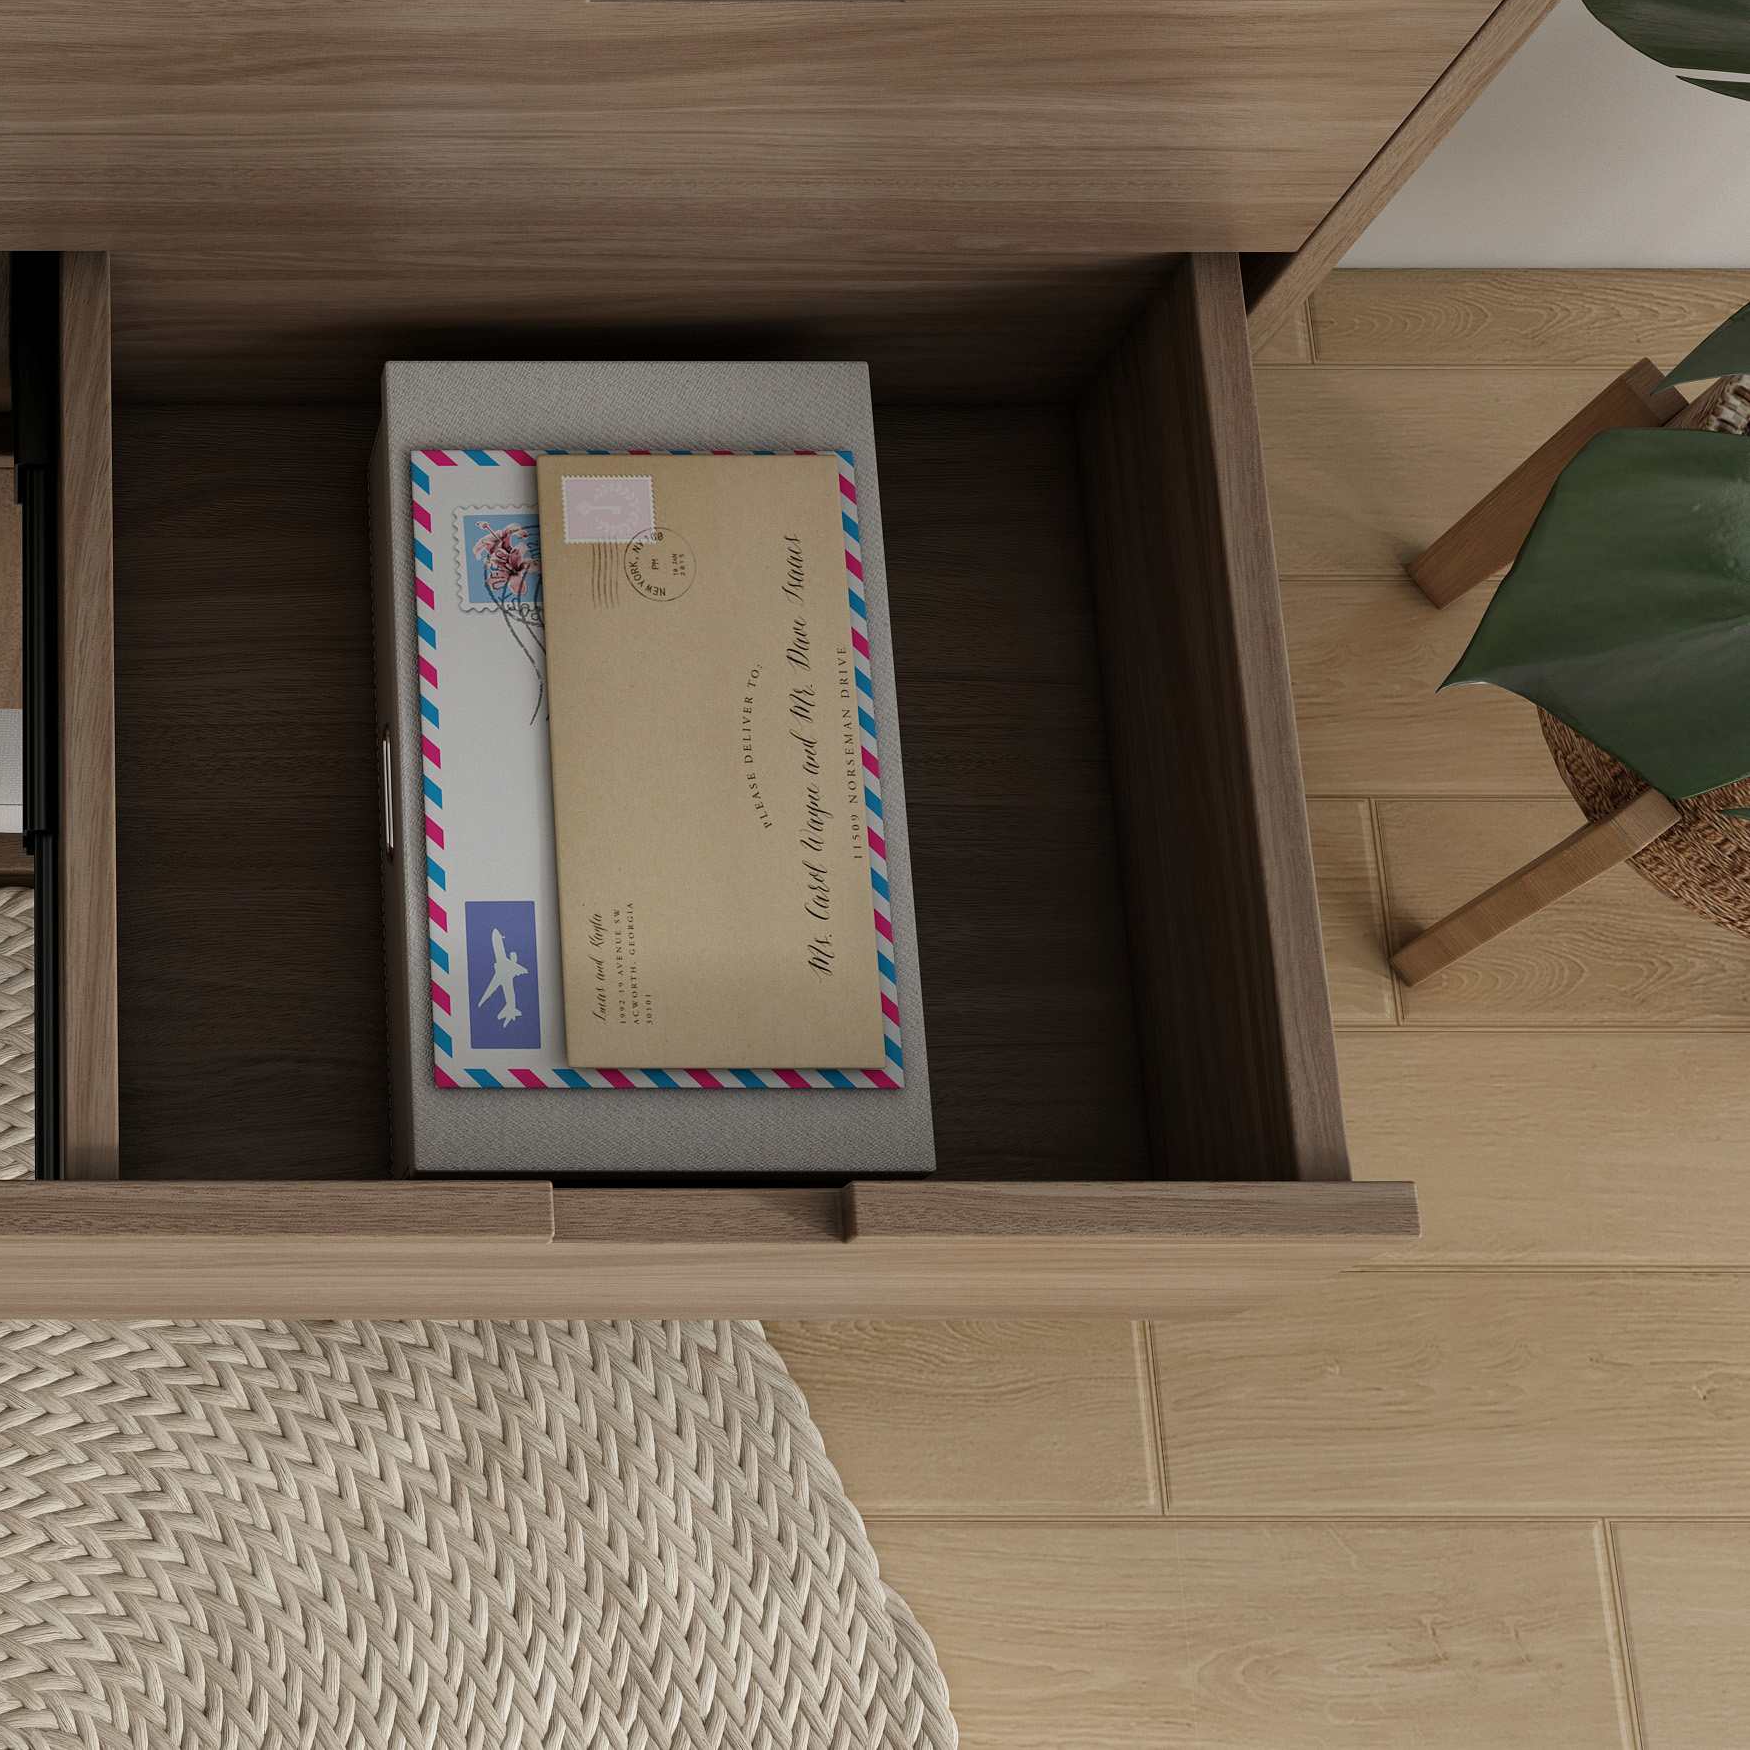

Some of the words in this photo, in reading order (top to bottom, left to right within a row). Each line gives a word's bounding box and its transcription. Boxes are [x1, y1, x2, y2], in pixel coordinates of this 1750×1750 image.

[651, 558, 659, 570] PM
[781, 534, 804, 602] Isaacs
[786, 616, 810, 673] Dave
[836, 647, 850, 698] DRIVE
[789, 684, 816, 724] Mr.
[742, 696, 754, 764] DELIVER
[789, 729, 820, 774] and
[841, 709, 859, 804] NORSEMAN
[747, 774, 772, 829] PLEASE
[799, 783, 833, 851] Wayne
[851, 814, 863, 859] 11509
[802, 860, 831, 921] Carol
[613, 909, 620, 924] SW
[626, 902, 636, 955] GEORGIA
[588, 954, 605, 981] and
[614, 930, 624, 976] AVENUE
[807, 934, 835, 981] Ms.
[618, 1000, 627, 1024] 1992
